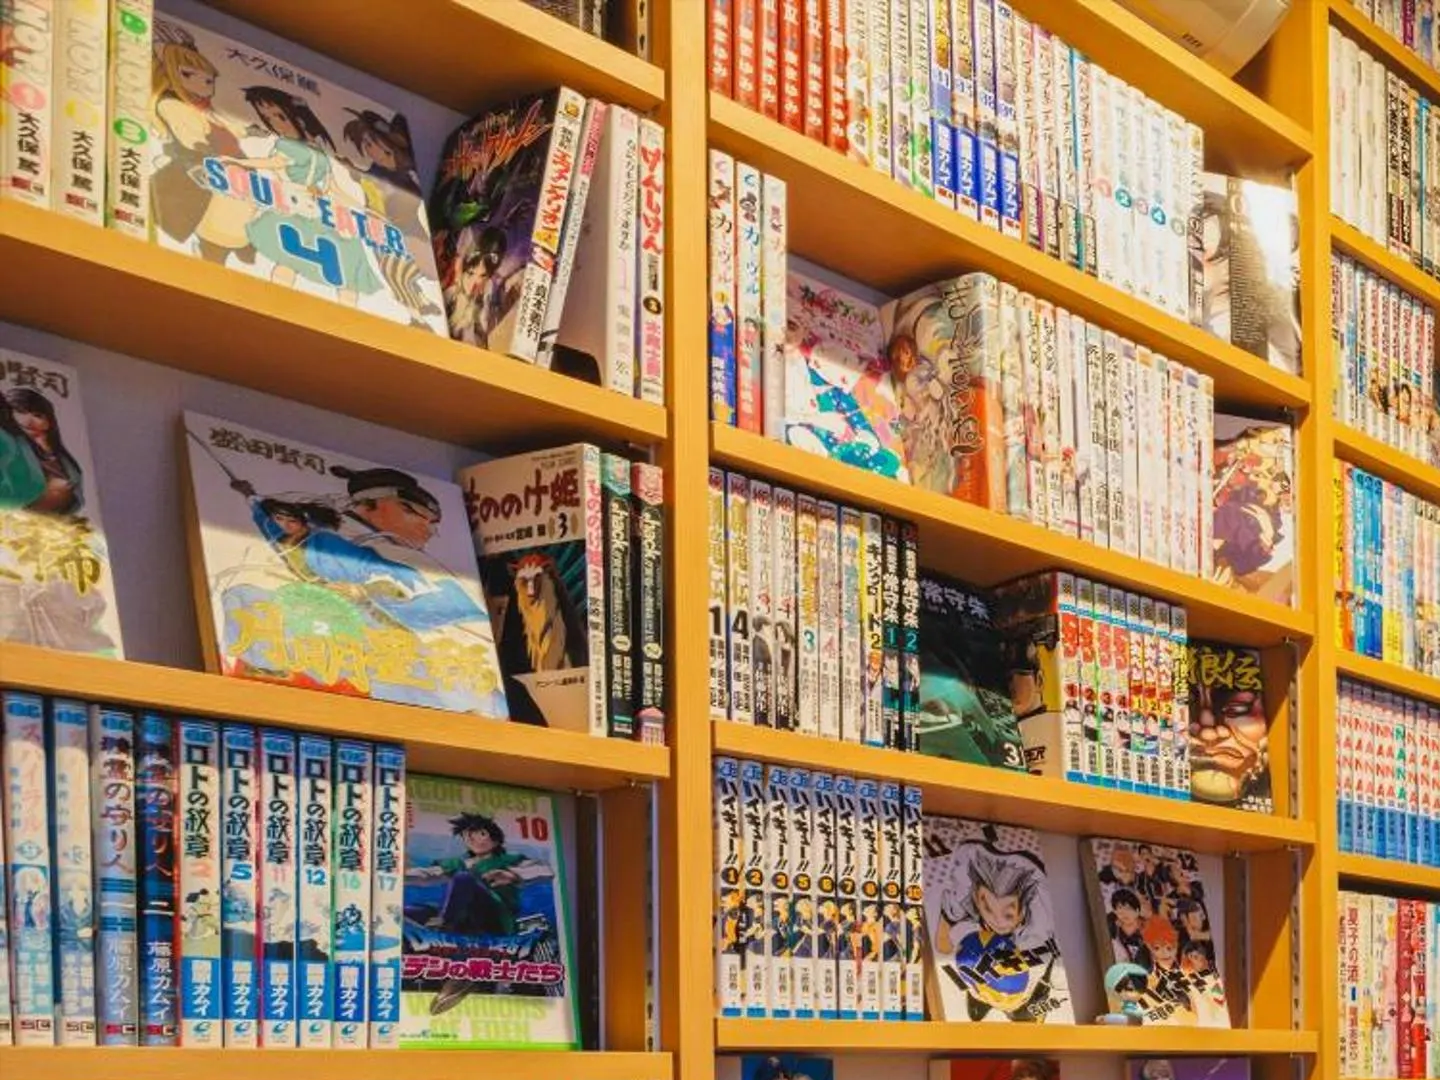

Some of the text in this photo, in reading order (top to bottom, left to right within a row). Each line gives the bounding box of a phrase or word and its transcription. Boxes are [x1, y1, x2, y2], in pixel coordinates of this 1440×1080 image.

[277, 222, 344, 287] 4
[0, 359, 69, 399] 賢司
[708, 605, 723, 637] 1
[731, 609, 750, 641] 4
[803, 628, 816, 650] 3
[905, 633, 918, 651] 2
[1188, 647, 1262, 690] 狼伝
[1003, 742, 1020, 766] 3
[1342, 715, 1353, 792] NANA
[1354, 717, 1364, 792] NANA
[1365, 719, 1375, 794] NANA
[1376, 723, 1386, 796] NANA
[1385, 725, 1395, 798] NANA
[1395, 724, 1406, 800] NANA
[1408, 731, 1418, 804] NANA
[1419, 734, 1430, 805] NANA
[1431, 738, 1440, 808] NANA
[184, 745, 211, 860] ロトの紋章
[225, 748, 250, 861] ロトの紋章
[266, 753, 291, 865] ロトの紋章
[303, 757, 327, 867] ロトの紋章
[339, 763, 363, 873] ロトの紋章
[376, 767, 399, 874] ロトの紋章
[515, 815, 549, 842] 10
[230, 862, 253, 881] 5
[305, 867, 327, 887] 12
[341, 872, 362, 891] 16
[402, 953, 566, 984] デンの戦士たち
